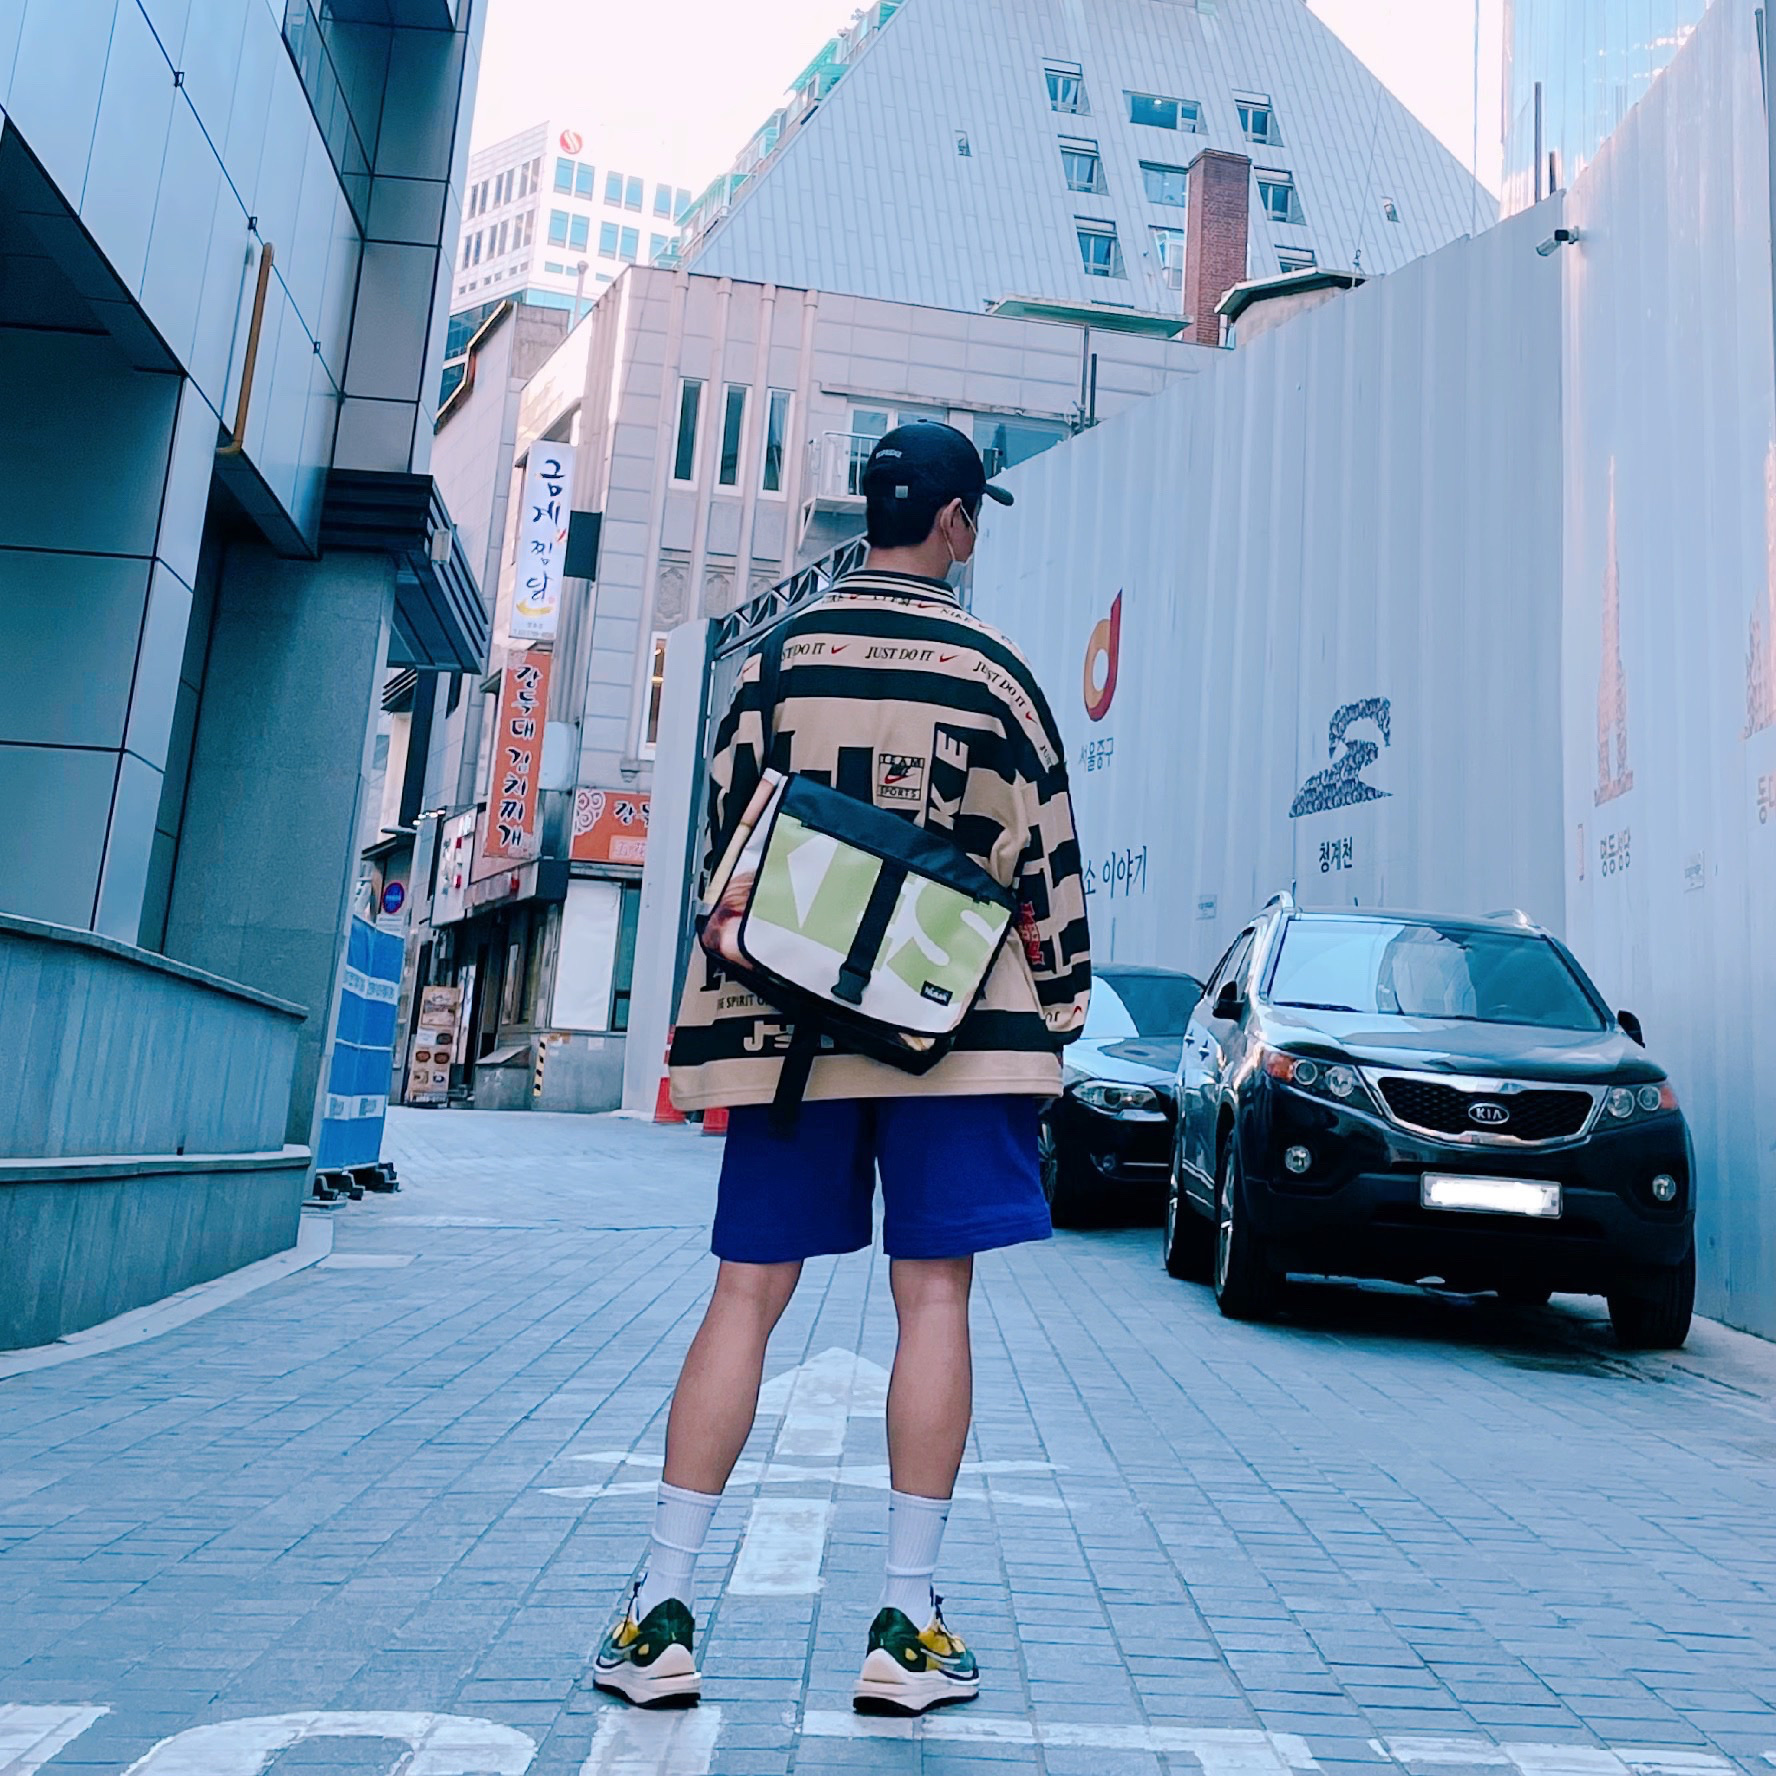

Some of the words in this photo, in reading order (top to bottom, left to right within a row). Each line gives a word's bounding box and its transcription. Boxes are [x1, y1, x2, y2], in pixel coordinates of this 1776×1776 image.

[812, 642, 826, 656] IT
[864, 645, 899, 660] JUST
[899, 647, 919, 661] DO
[919, 649, 935, 662] IT
[972, 660, 1002, 683] JUST
[999, 678, 1017, 697] DO
[1014, 694, 1027, 708] IT
[879, 753, 924, 769] TEAM
[498, 748, 531, 848] 김치찌개
[879, 786, 920, 800] SPORTS
[1318, 836, 1353, 873] 청계천
[1102, 845, 1147, 899] 이야기
[726, 994, 754, 1009] SPIRIT
[1475, 1107, 1502, 1120] KIA
